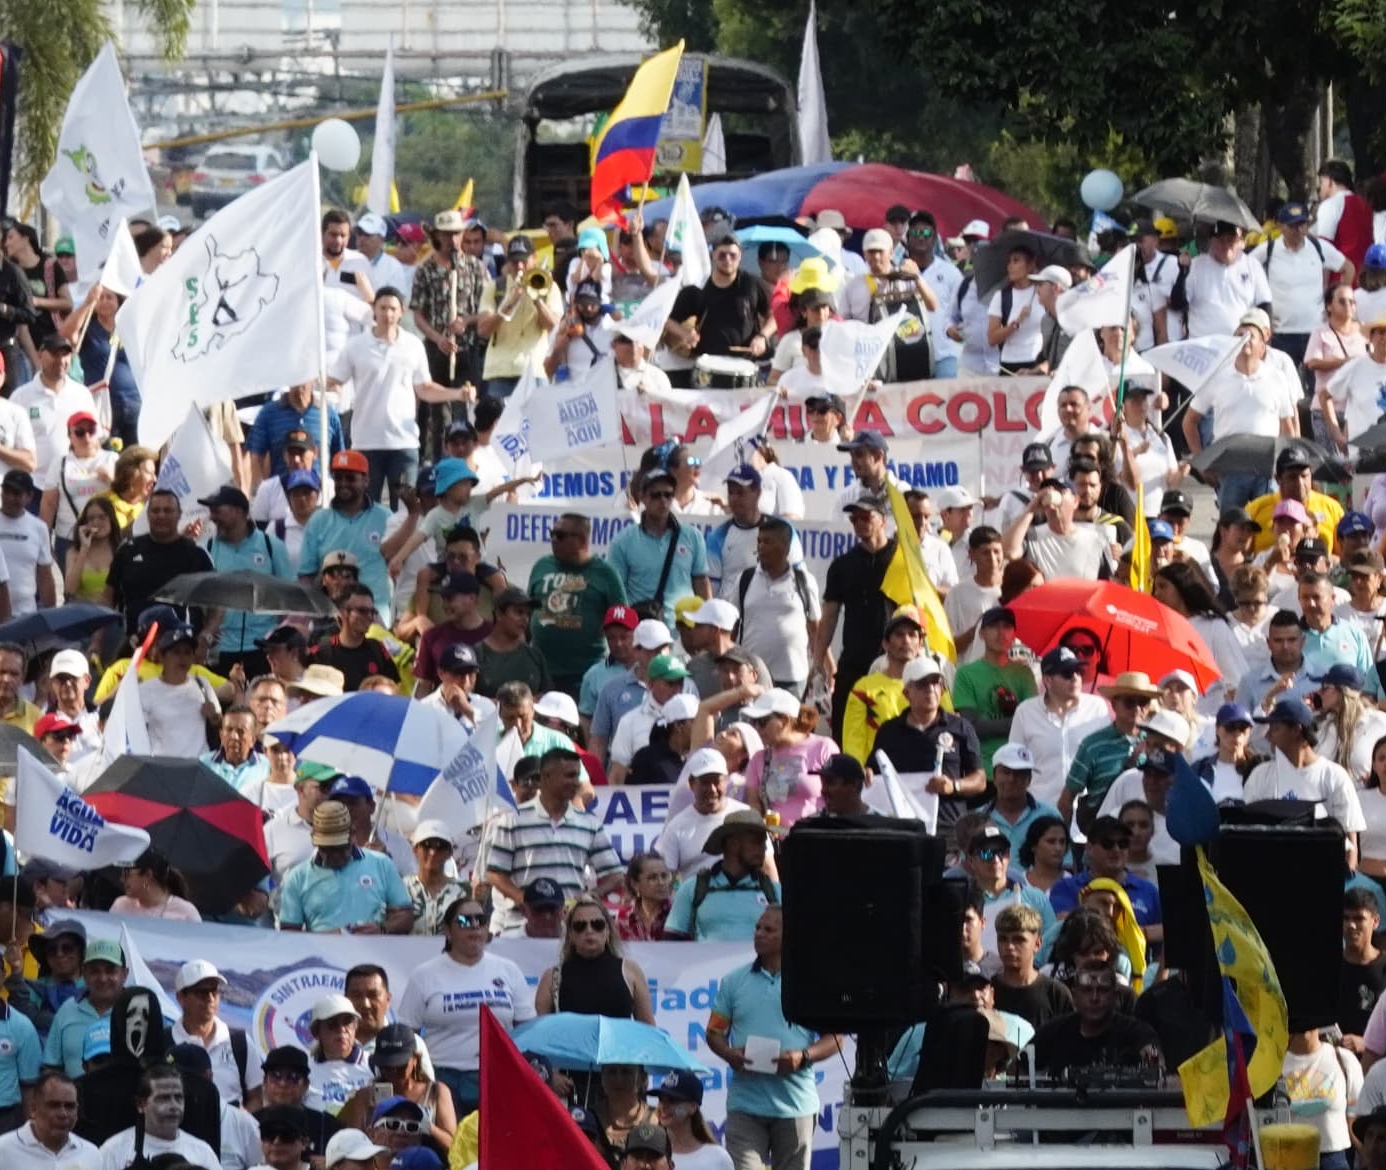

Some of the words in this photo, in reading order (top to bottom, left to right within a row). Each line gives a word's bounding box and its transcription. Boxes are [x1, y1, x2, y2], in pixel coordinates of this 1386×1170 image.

[539, 471, 614, 498] DEMOS
[49, 815, 95, 853] VIDA
[269, 973, 346, 1006] SINTRAEM
